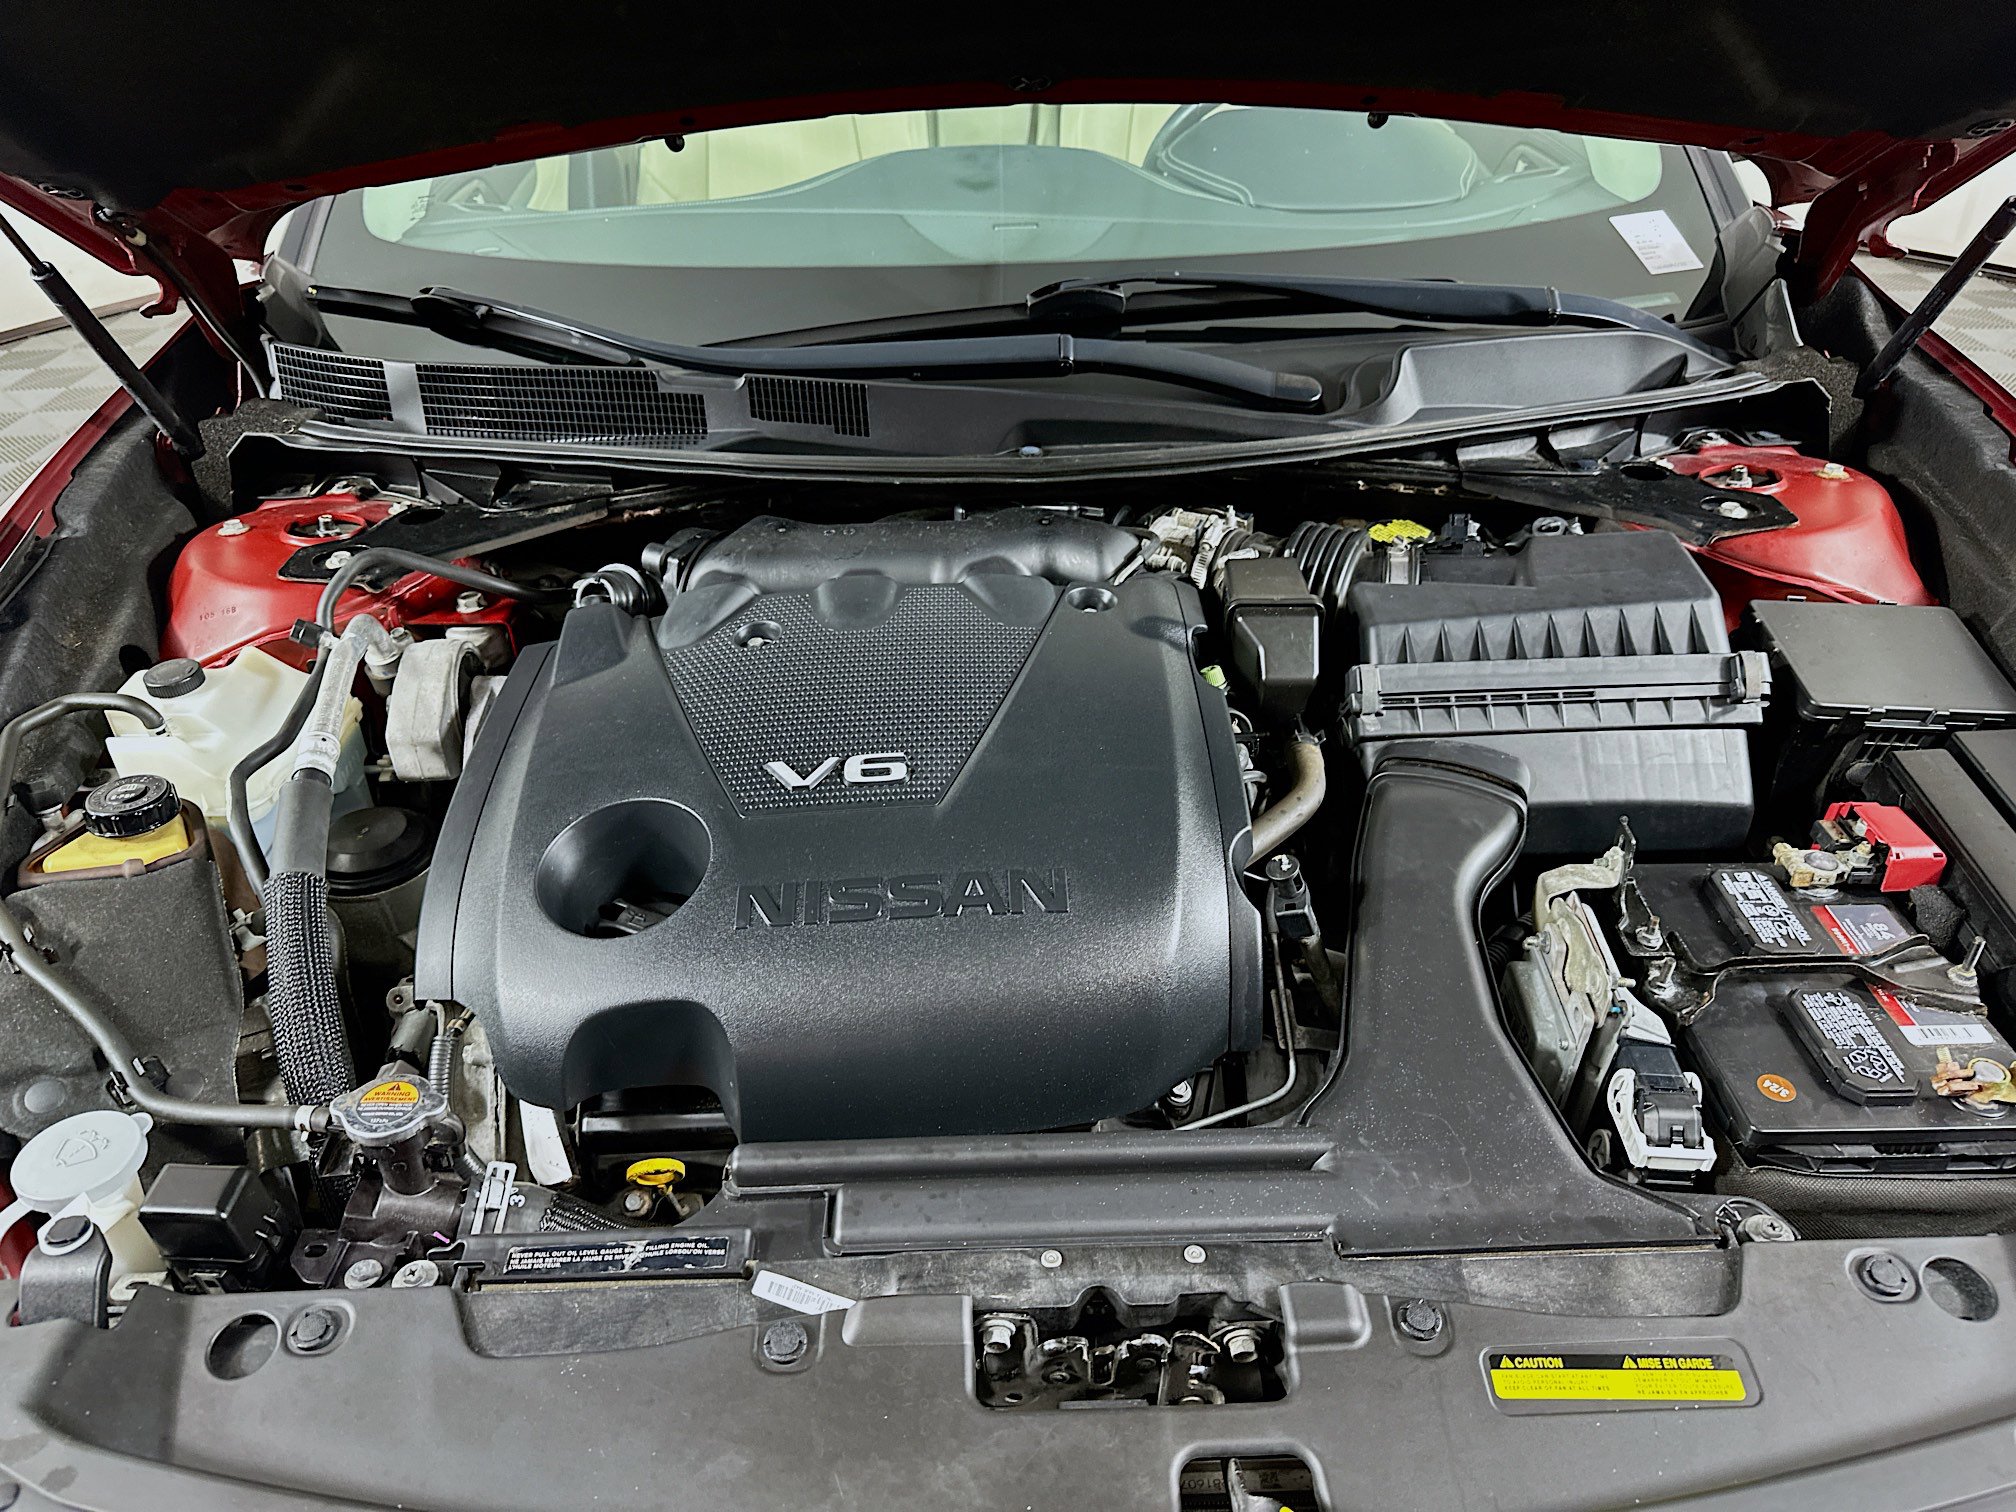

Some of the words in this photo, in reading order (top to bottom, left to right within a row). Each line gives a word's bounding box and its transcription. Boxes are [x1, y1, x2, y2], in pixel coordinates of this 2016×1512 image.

[762, 752, 909, 791] V6
[734, 868, 1069, 930] NISSAN
[646, 1243, 670, 1251] FILLING
[1514, 1357, 1564, 1369] CAUTION
[1637, 1357, 1662, 1369] MISE
[1662, 1357, 1678, 1369] EN
[1678, 1358, 1714, 1369] GARDE
